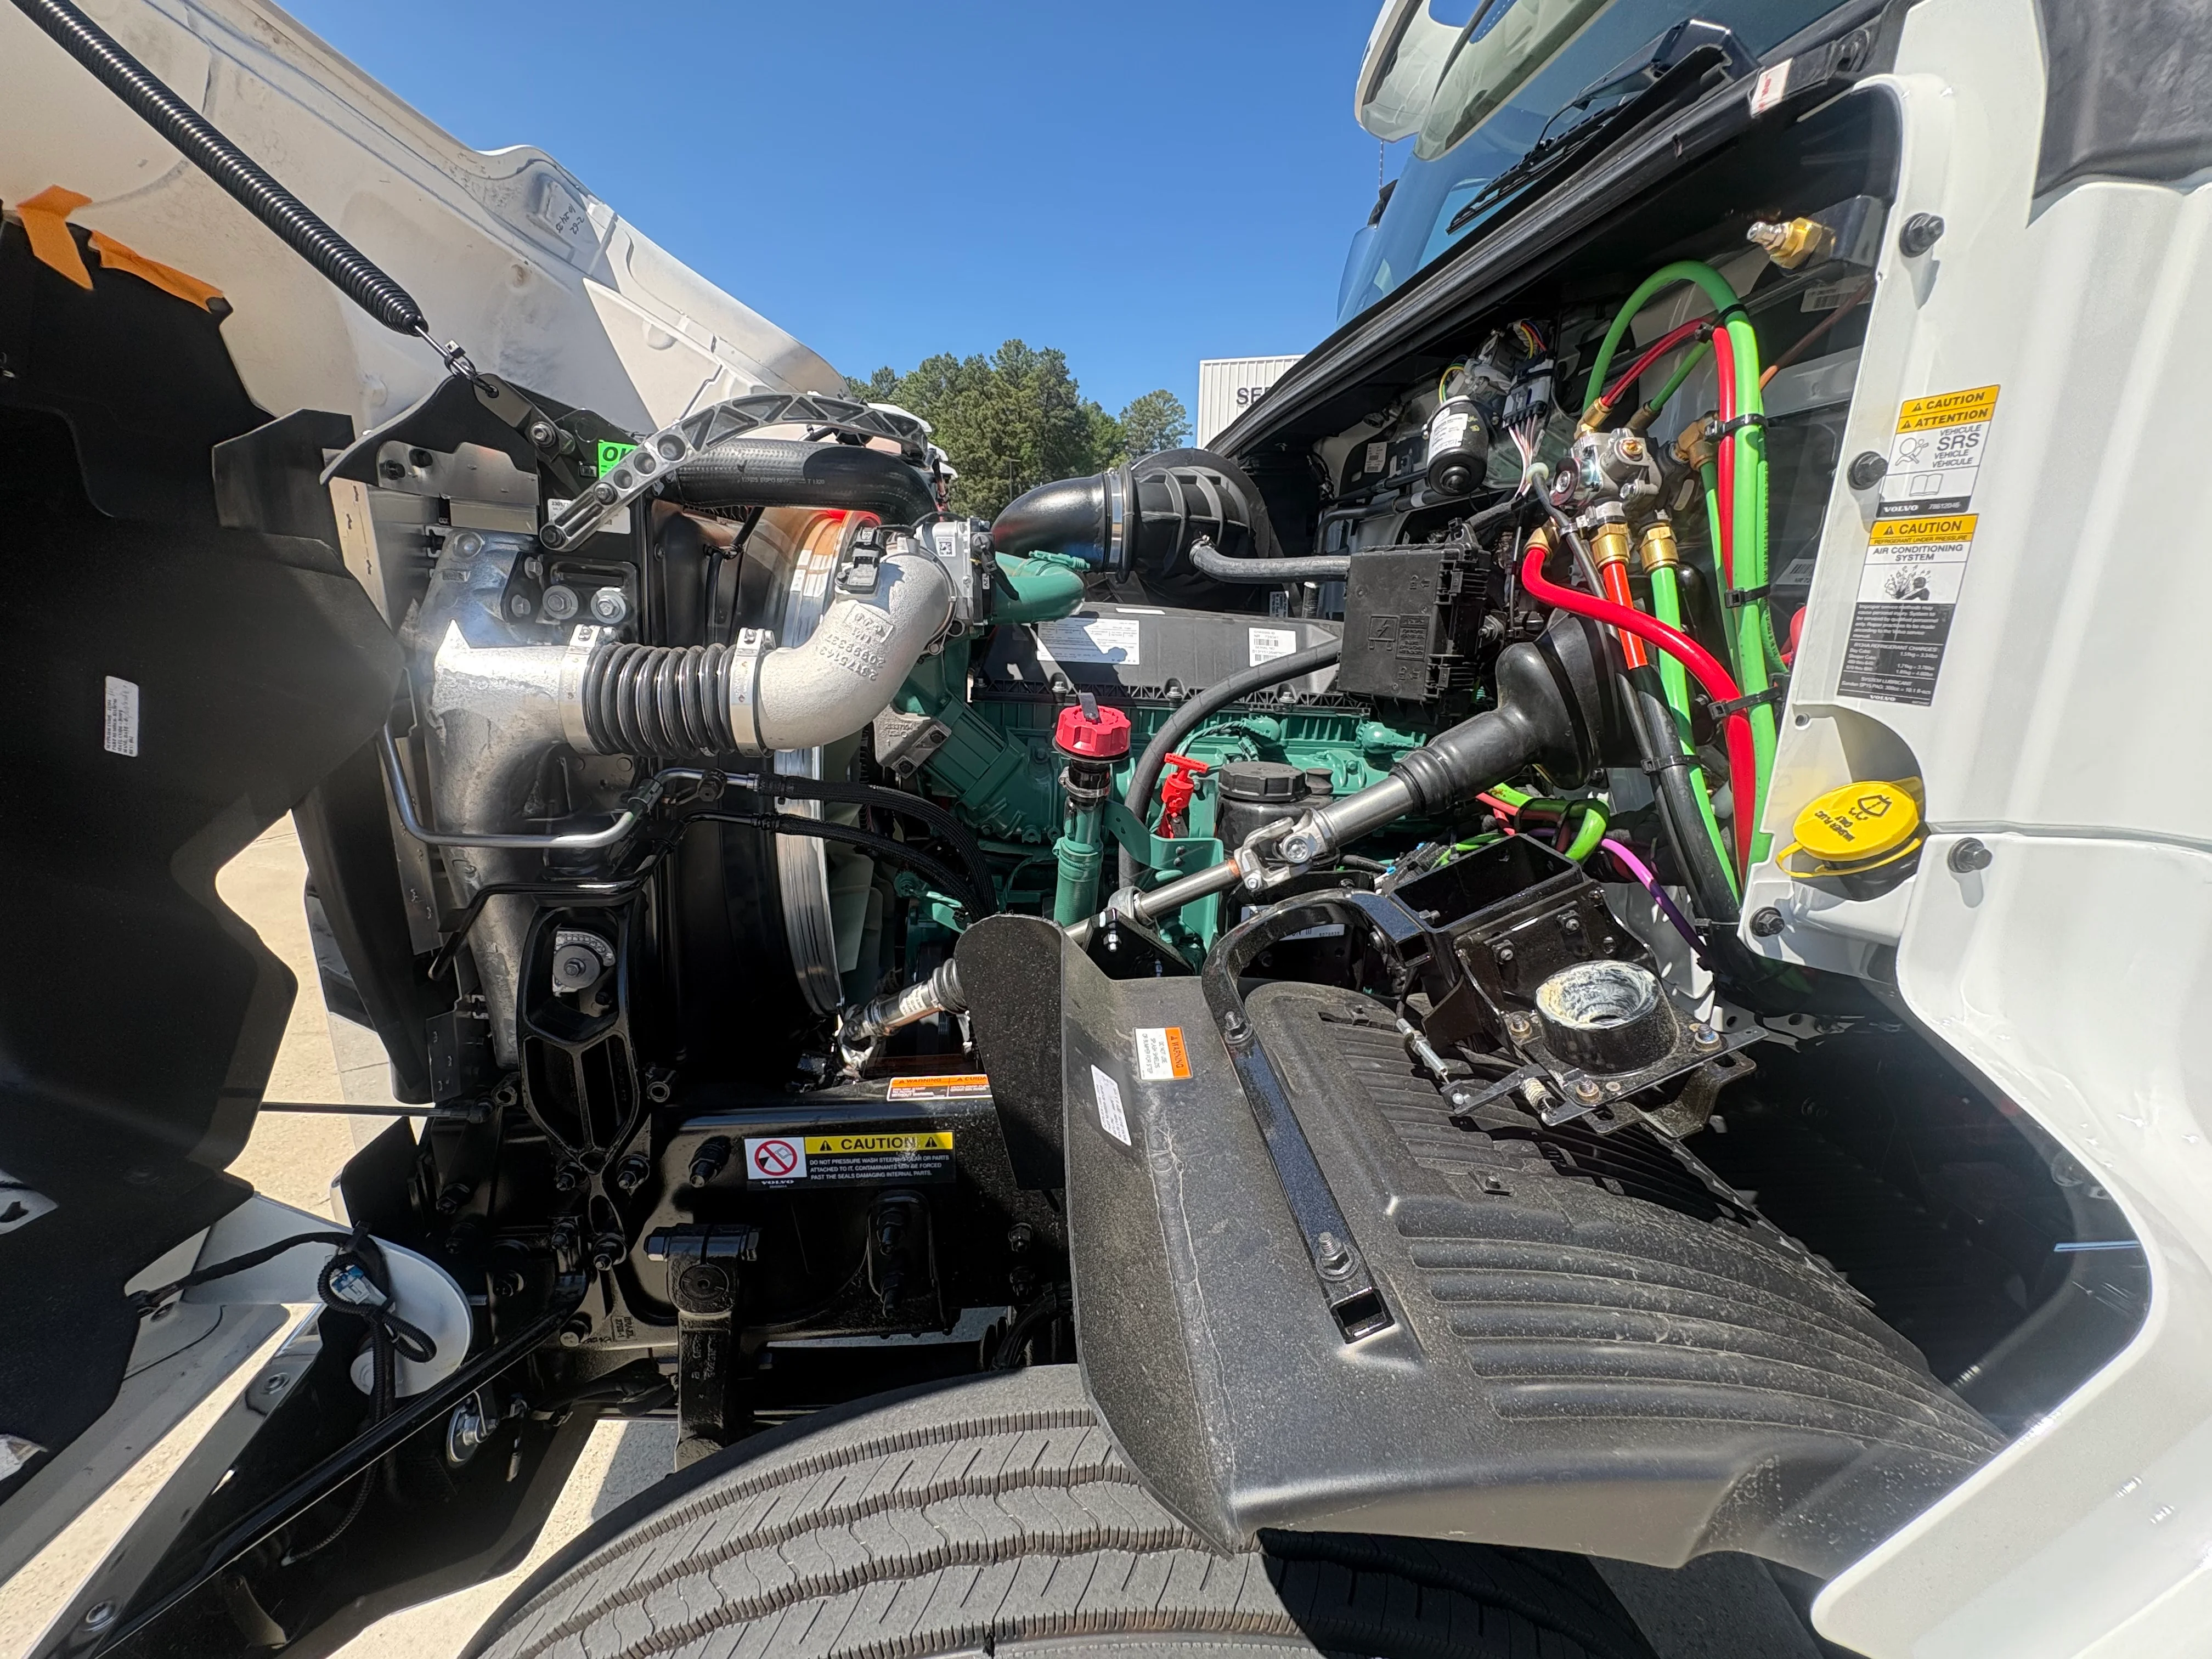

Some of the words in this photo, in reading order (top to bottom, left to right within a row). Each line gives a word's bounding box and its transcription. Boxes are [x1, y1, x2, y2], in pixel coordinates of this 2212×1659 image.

[1927, 391, 1986, 410] CAUTION
[1915, 408, 1988, 428] ATTENTION
[1937, 433, 1980, 451] SRS
[1934, 449, 1969, 460] VEHICLE
[1883, 504, 1919, 513] VOLVO
[1899, 520, 1962, 534] CAUTION
[1873, 546, 1889, 555] AIR
[1891, 544, 1963, 554] CONDITIONING
[1895, 554, 1935, 562] SYSTEM
[1171, 1041, 1184, 1069] WARNING
[841, 1137, 915, 1150] CAUTION
